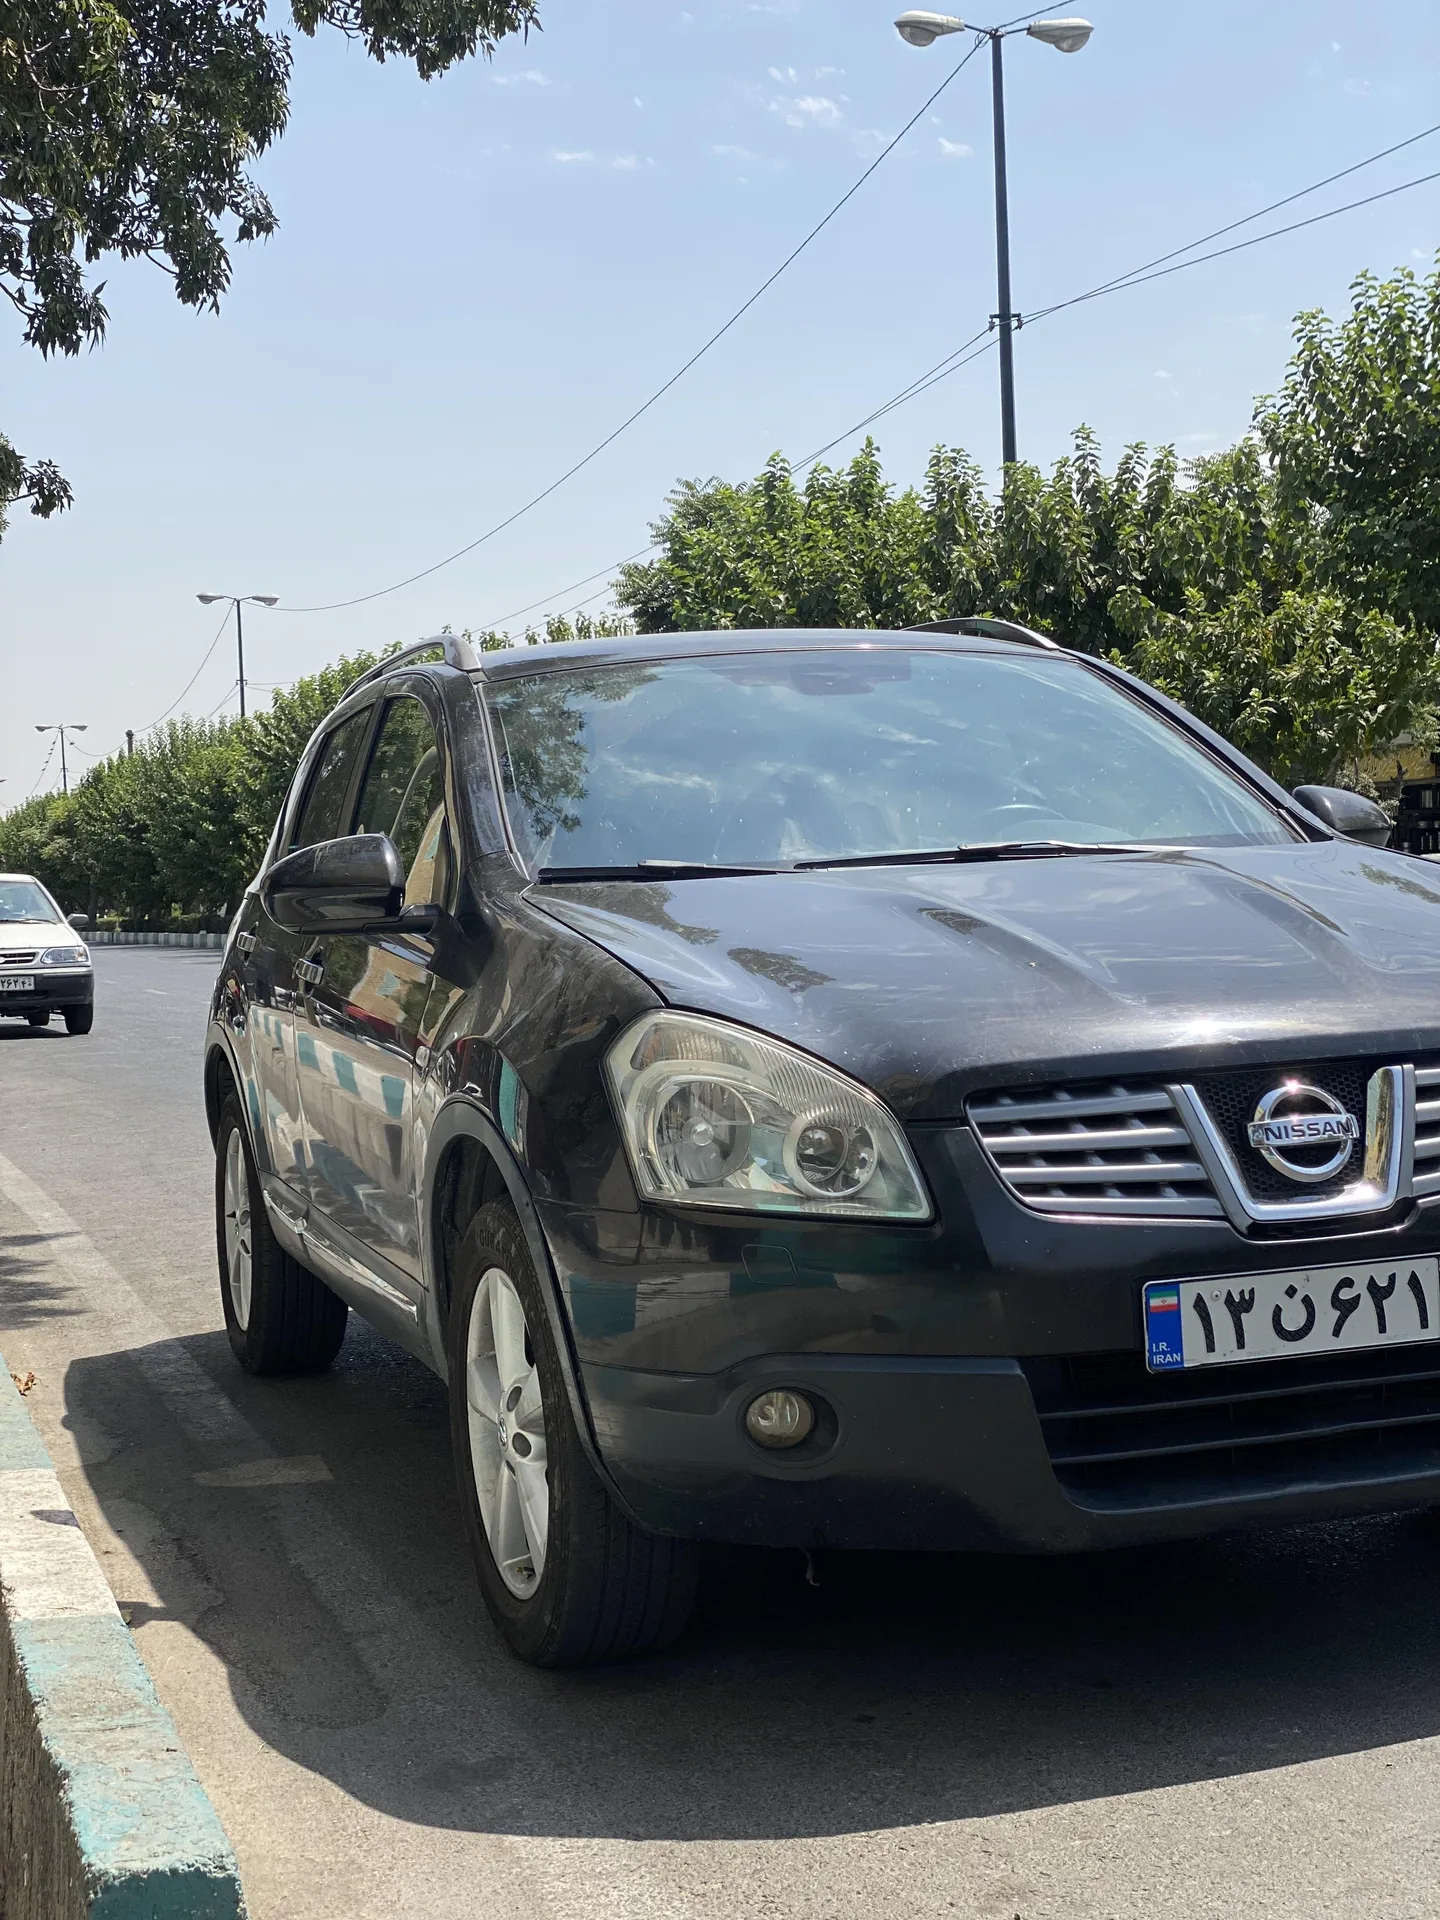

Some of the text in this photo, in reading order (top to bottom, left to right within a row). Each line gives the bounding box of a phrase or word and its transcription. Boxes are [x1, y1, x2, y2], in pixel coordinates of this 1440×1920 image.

[1264, 1118, 1352, 1141] NISSAN
[1152, 1342, 1171, 1353] I.R.
[1153, 1353, 1181, 1365] IRAN
